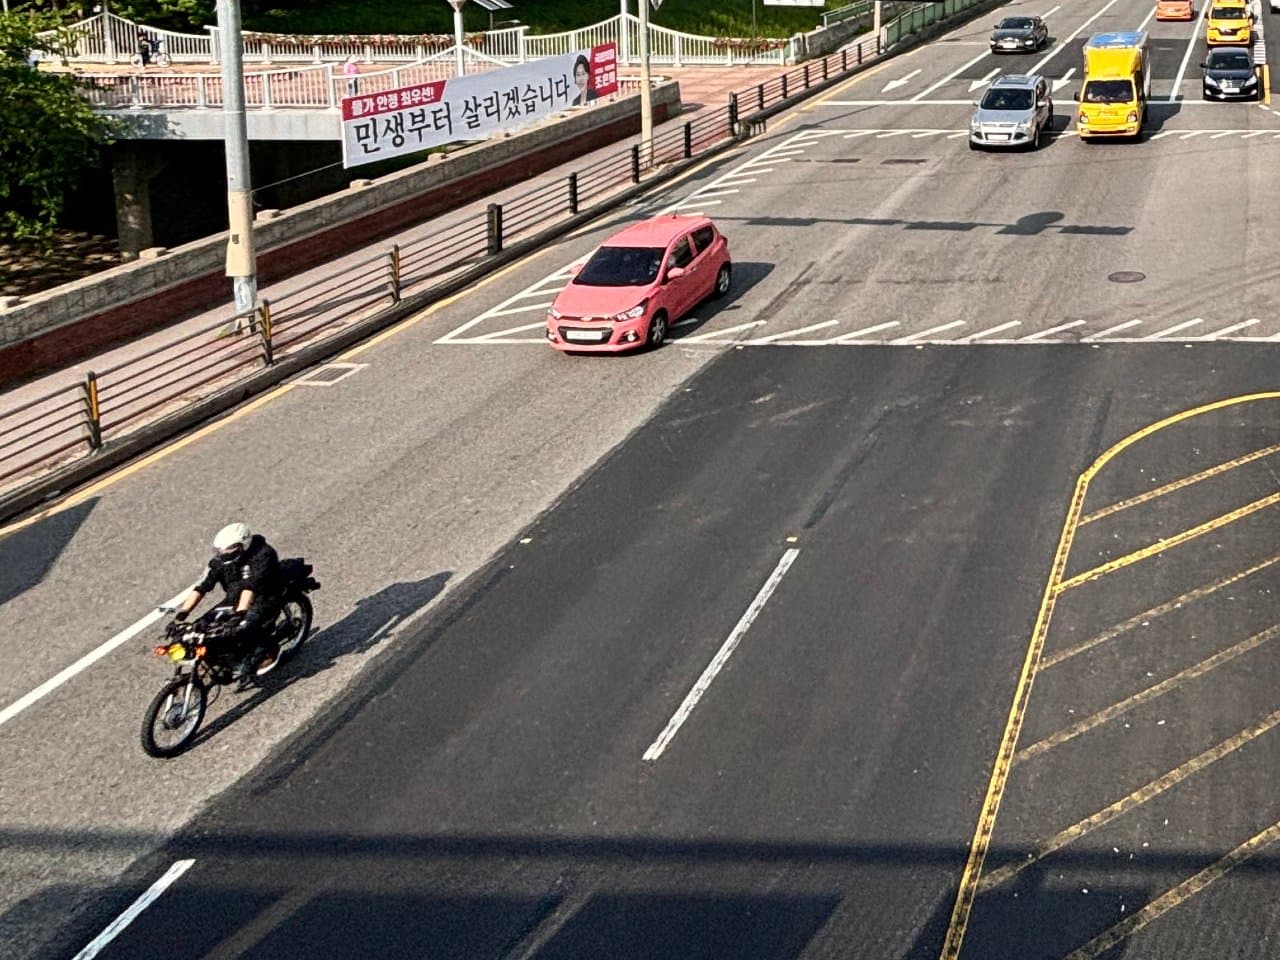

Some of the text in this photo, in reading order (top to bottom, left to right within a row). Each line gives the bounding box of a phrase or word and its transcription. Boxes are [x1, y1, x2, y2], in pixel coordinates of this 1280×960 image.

[353, 73, 570, 155] 민생부터 살리겠습니다
[376, 93, 399, 111] 안정
[400, 86, 435, 106] 최우선!
